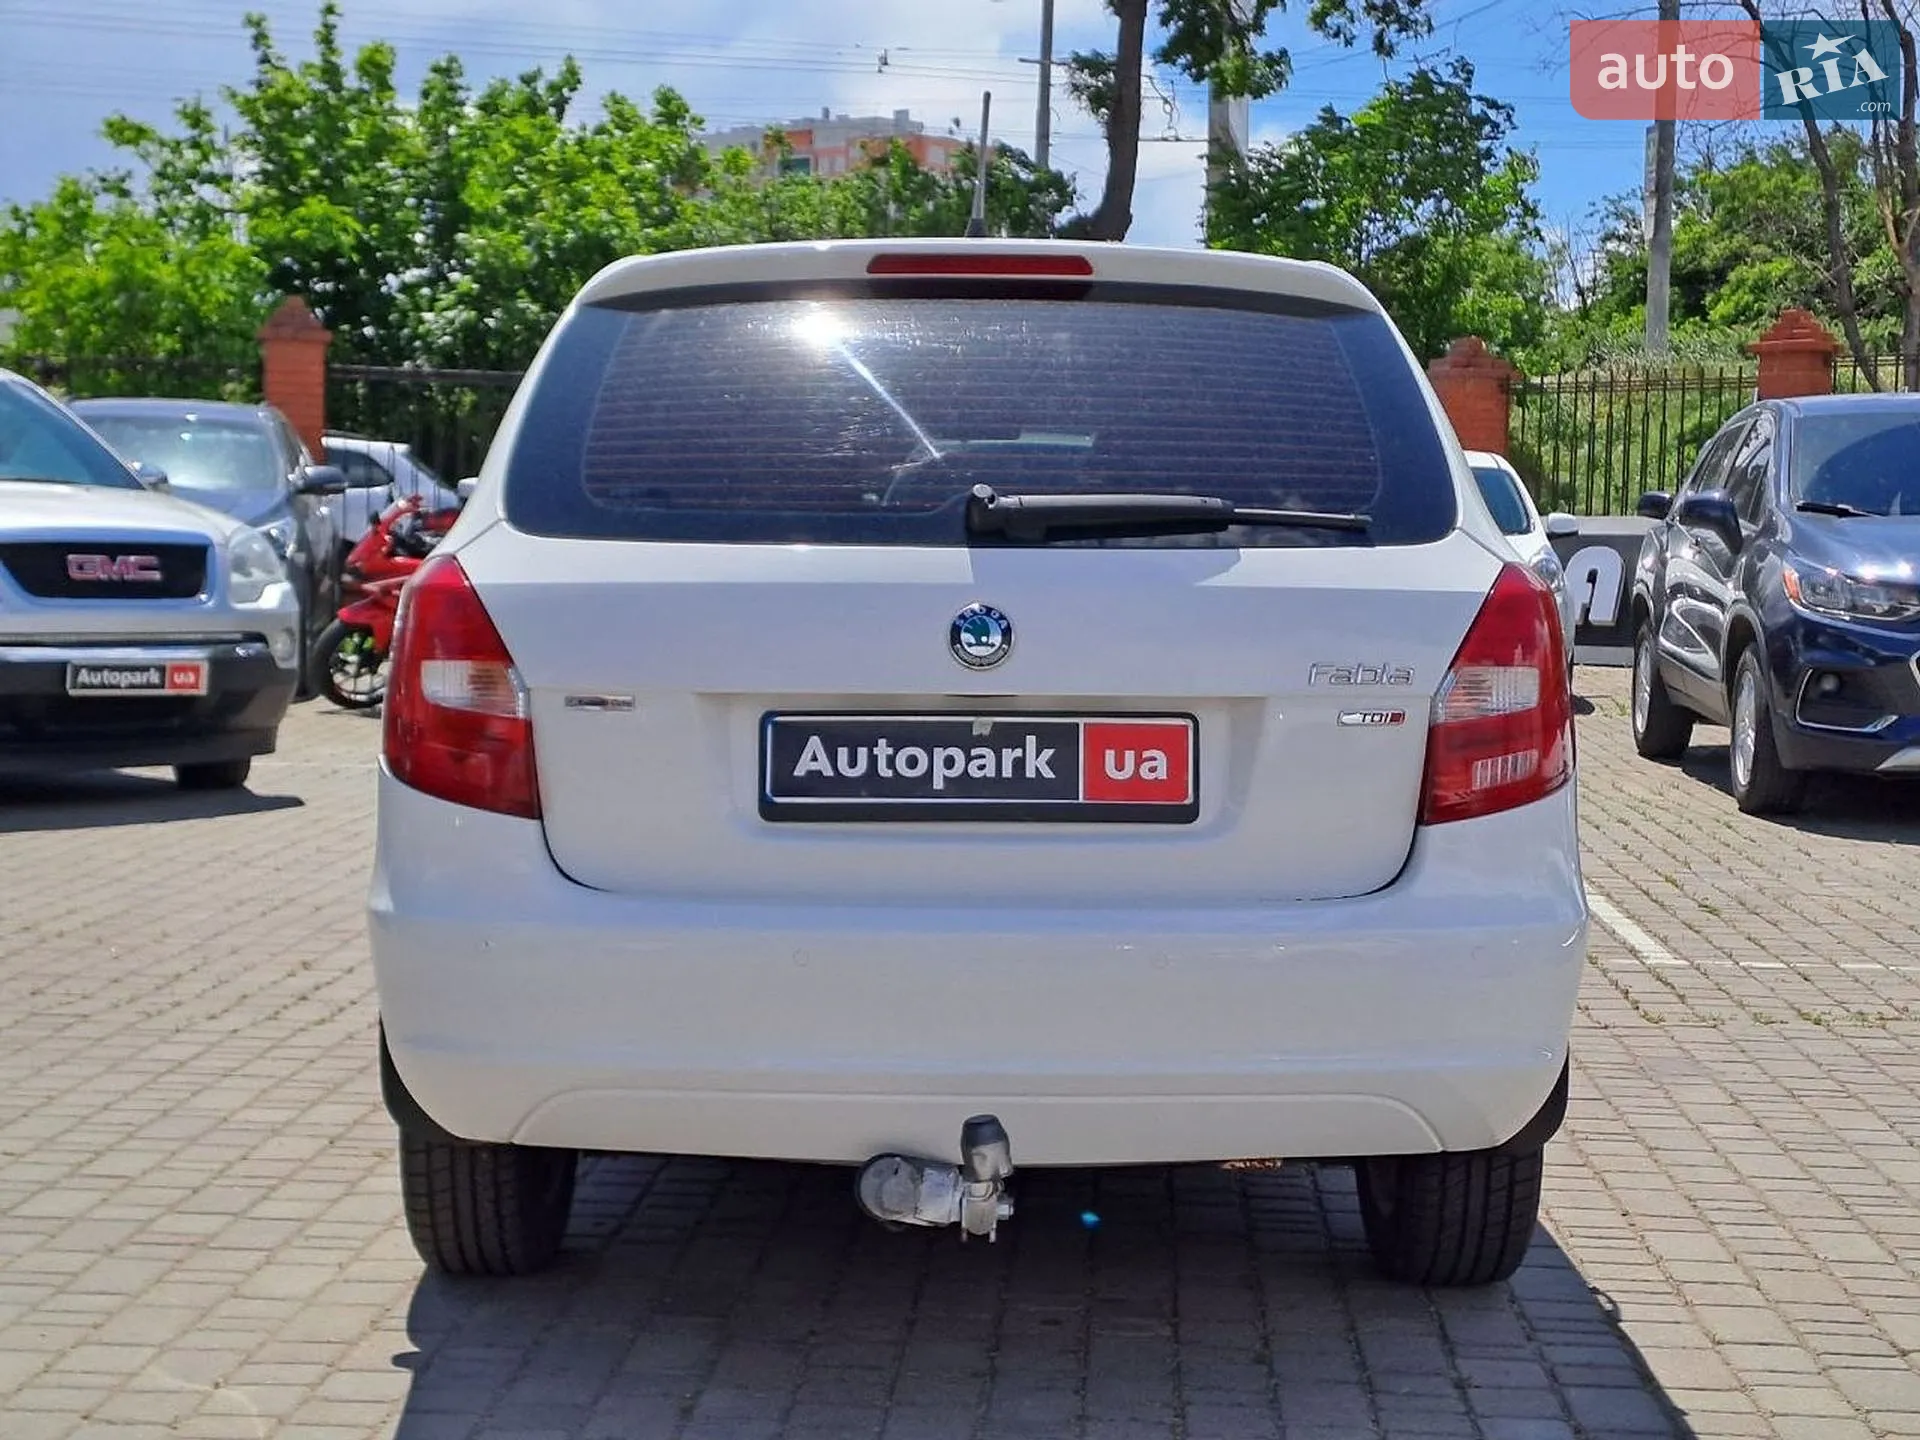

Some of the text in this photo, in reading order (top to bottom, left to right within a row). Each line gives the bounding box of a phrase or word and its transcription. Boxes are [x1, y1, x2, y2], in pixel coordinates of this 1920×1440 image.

[67, 554, 161, 581] GMC
[77, 667, 196, 688] Autopark ua
[793, 735, 1168, 790] Autopark ua
